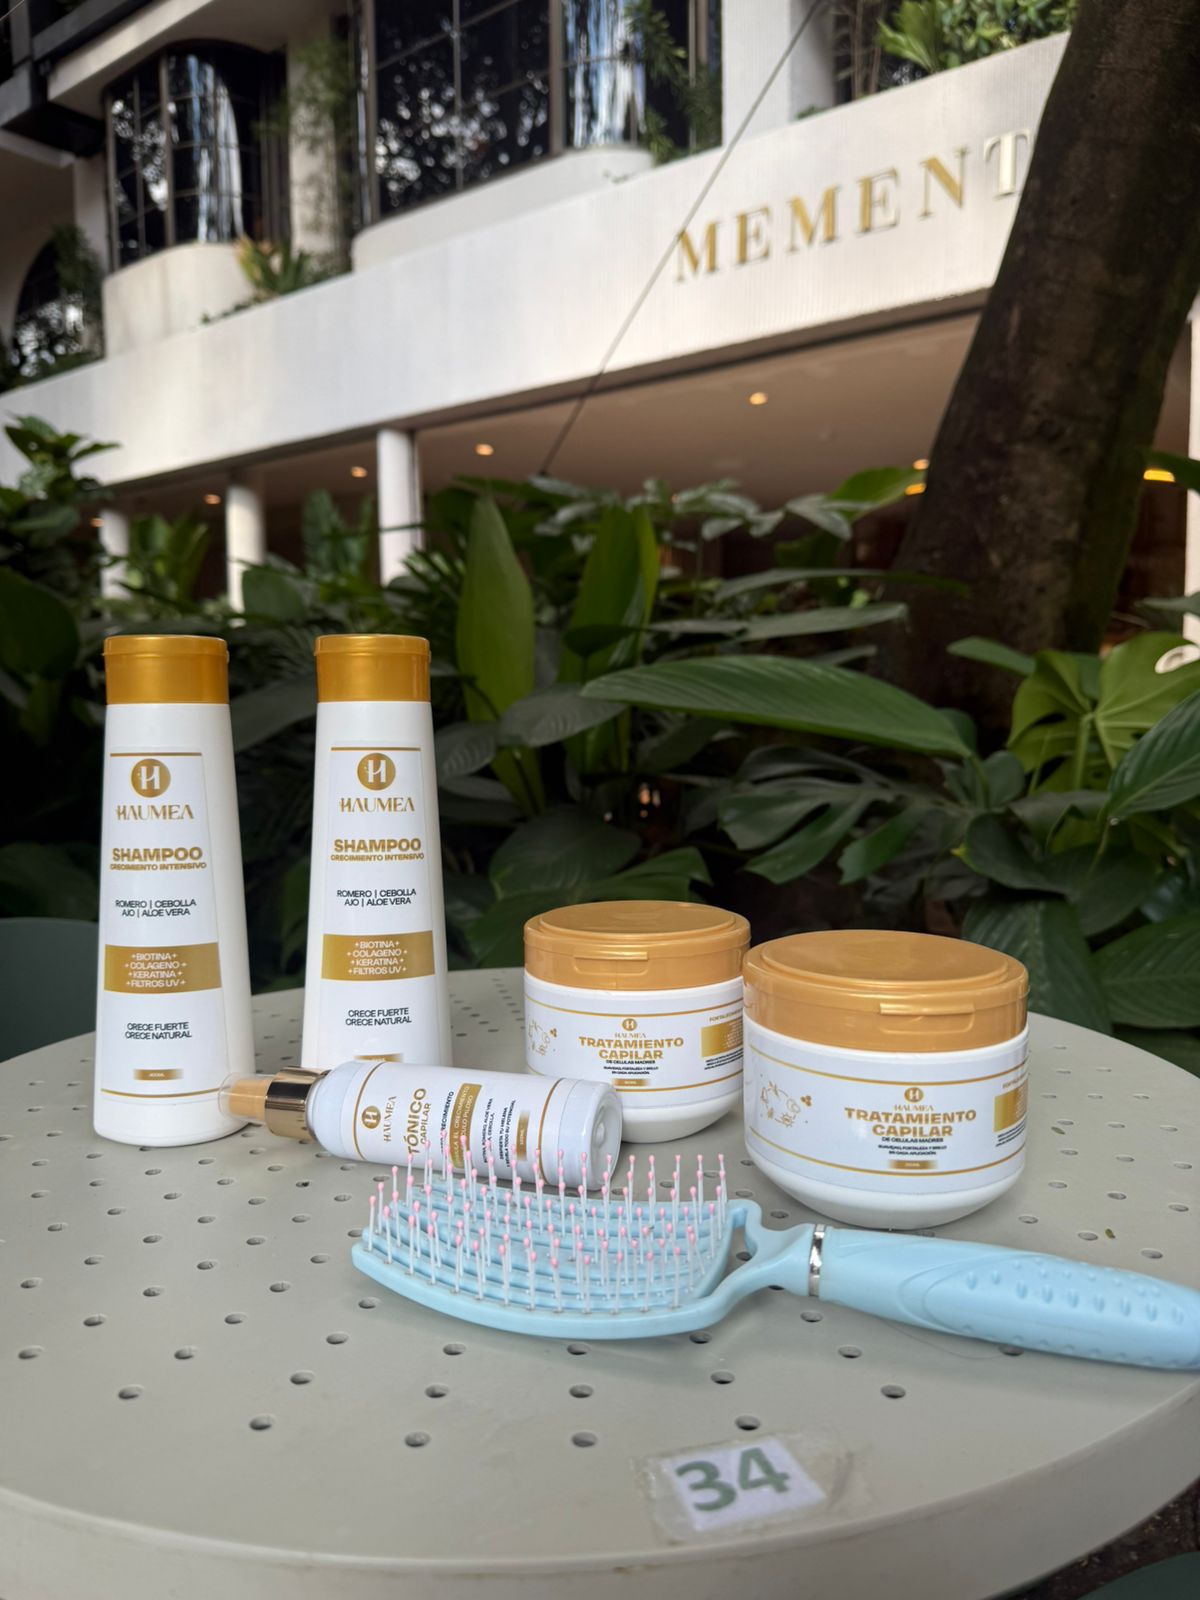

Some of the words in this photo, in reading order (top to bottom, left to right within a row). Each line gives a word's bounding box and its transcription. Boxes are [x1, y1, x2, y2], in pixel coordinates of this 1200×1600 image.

[339, 797, 415, 813] HAUMEA
[116, 804, 195, 821] HAUMEA
[334, 837, 422, 854] SHAMPOO
[112, 846, 203, 863] SHAMPOO
[330, 854, 383, 863] CRECIMIENTO
[384, 853, 425, 862] INTENSIVO
[159, 862, 207, 871] INTENSIVO
[336, 889, 373, 899] ROMERO
[379, 888, 417, 898] CEBOLLA
[115, 900, 148, 909] ROMERO
[155, 898, 197, 908] CEBOLLA
[344, 898, 360, 907] AJO
[366, 898, 388, 907] ALOE
[389, 897, 412, 905] VERA
[122, 909, 136, 917] AJO
[141, 909, 165, 917] ALOE
[164, 908, 191, 917] VERA
[359, 940, 396, 949] BIOTINA
[135, 952, 172, 961] BIOTINA
[352, 948, 402, 958] COLAGENO
[129, 961, 181, 970] COLAGENO
[355, 957, 399, 966] KERATINA
[132, 970, 177, 979] KERATINA
[353, 966, 388, 975] FILTROS
[388, 966, 402, 975] UV
[130, 980, 165, 988] FILTROS
[165, 979, 180, 988] UV
[347, 1009, 376, 1018] CRECE
[377, 1007, 409, 1018] FUERTE
[126, 1022, 154, 1032] CRECE
[154, 1021, 190, 1031] FUERTE
[345, 1018, 374, 1027] CRECE
[374, 1016, 413, 1027] NATURAL
[124, 1031, 152, 1041] CRECE
[151, 1030, 193, 1041] NATURAL
[578, 1036, 685, 1050] TRATAMIENTO
[598, 1049, 664, 1060] CAPILAR
[441, 1091, 455, 1133] RECIMIENTO
[844, 1107, 977, 1125] TRATAMIENTO
[403, 1087, 428, 1154] TÓNICO
[420, 1102, 432, 1145] CAPILAR
[871, 1124, 953, 1138] CAPILAR
[675, 1446, 791, 1513] 34
